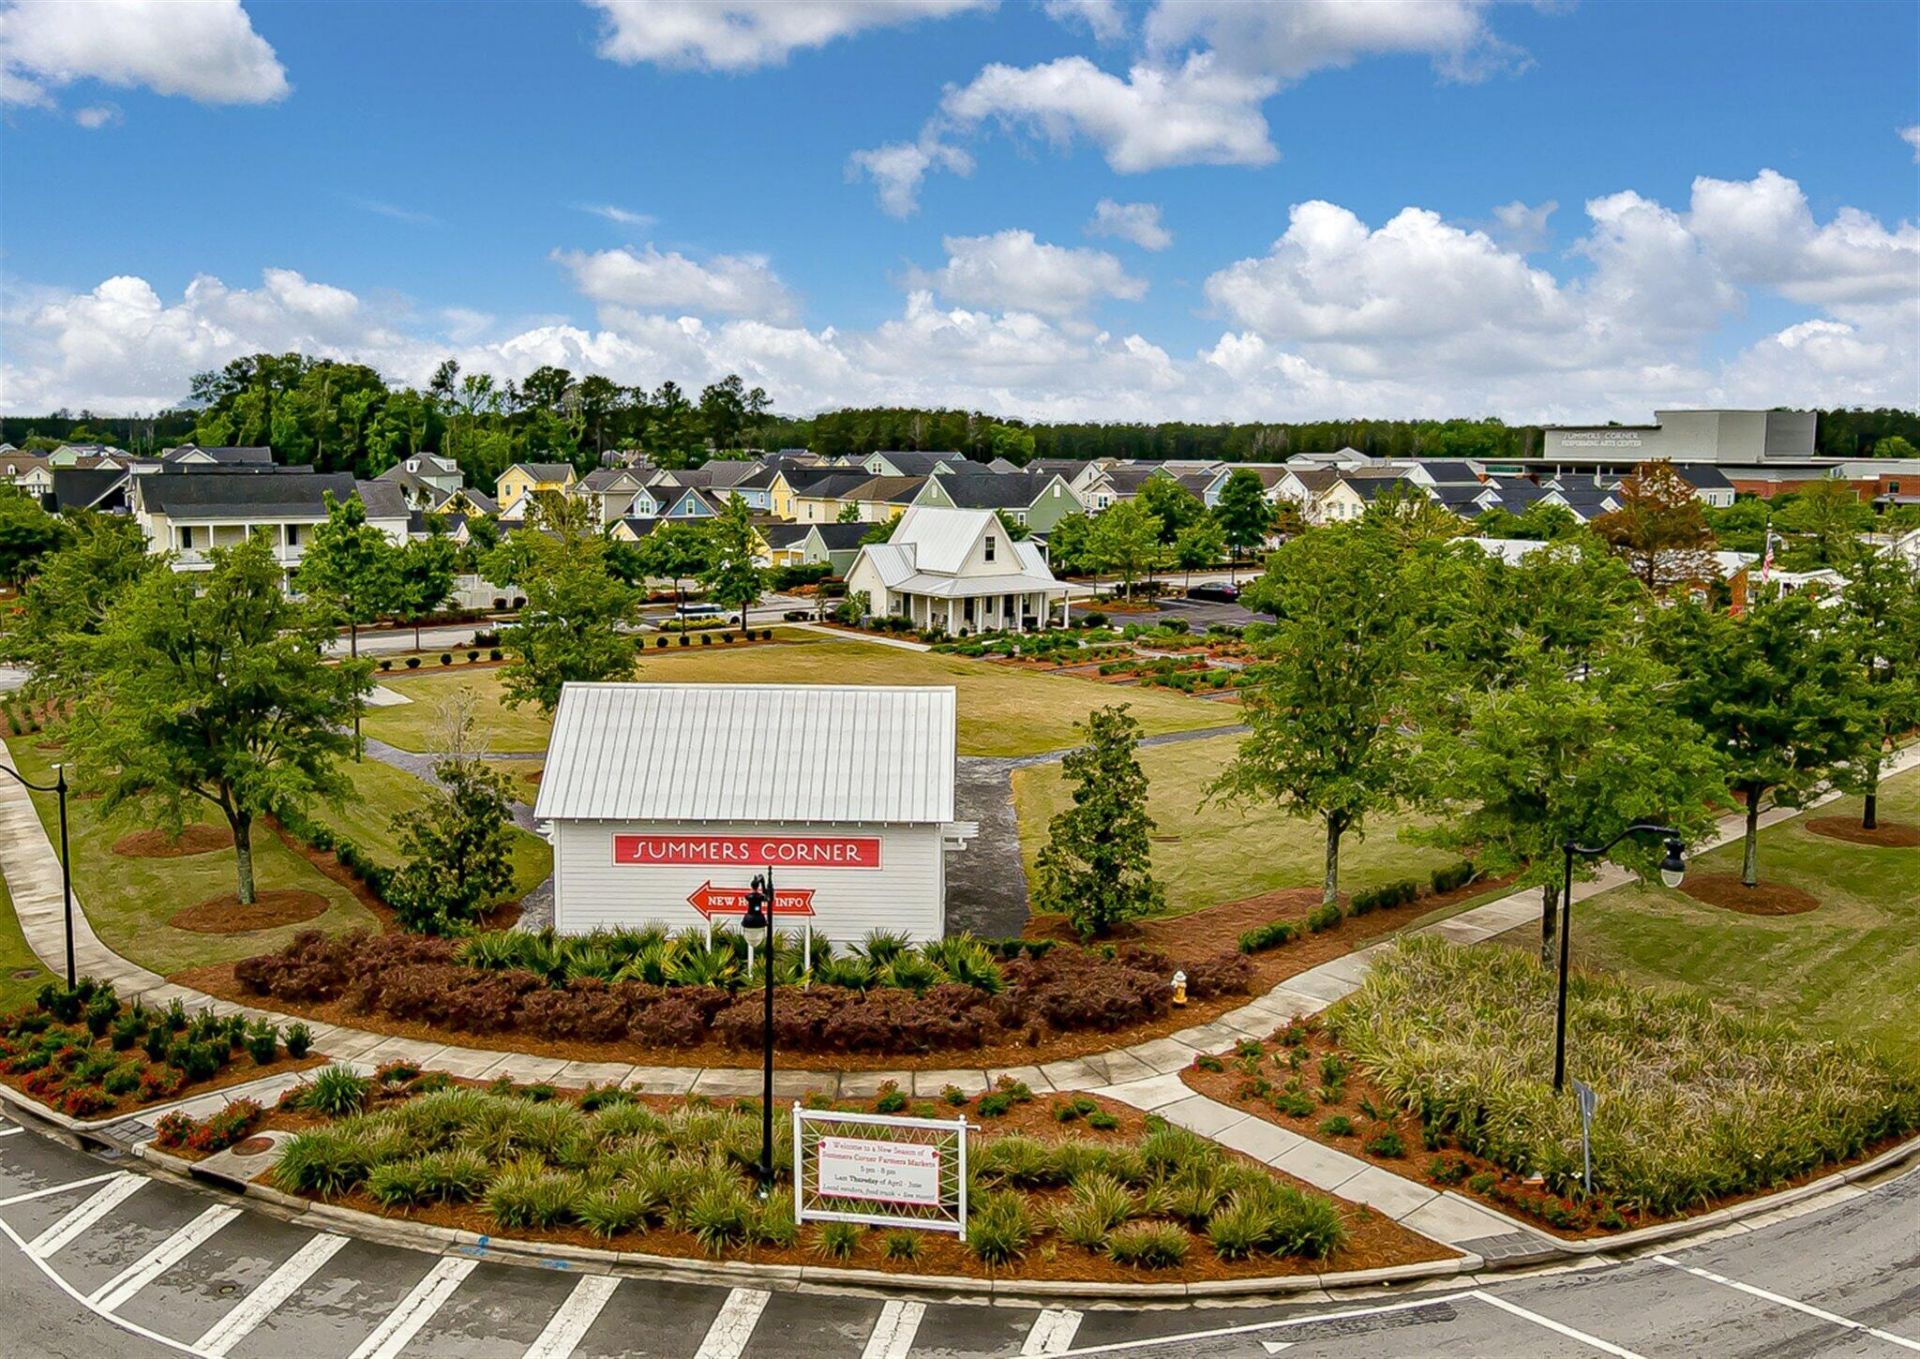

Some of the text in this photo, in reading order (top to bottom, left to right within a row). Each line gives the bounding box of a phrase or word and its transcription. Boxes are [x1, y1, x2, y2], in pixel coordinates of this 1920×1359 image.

[633, 841, 862, 862] SUMMERS CORNER
[708, 896, 736, 906] NEW
[775, 898, 804, 908] INFO
[832, 1141, 862, 1150] Welcome
[822, 1151, 852, 1160] Summers
[854, 1154, 876, 1162] Corner
[878, 1156, 906, 1164] Farmers
[849, 1175, 878, 1185] Thursday
[888, 1180, 903, 1188] April
